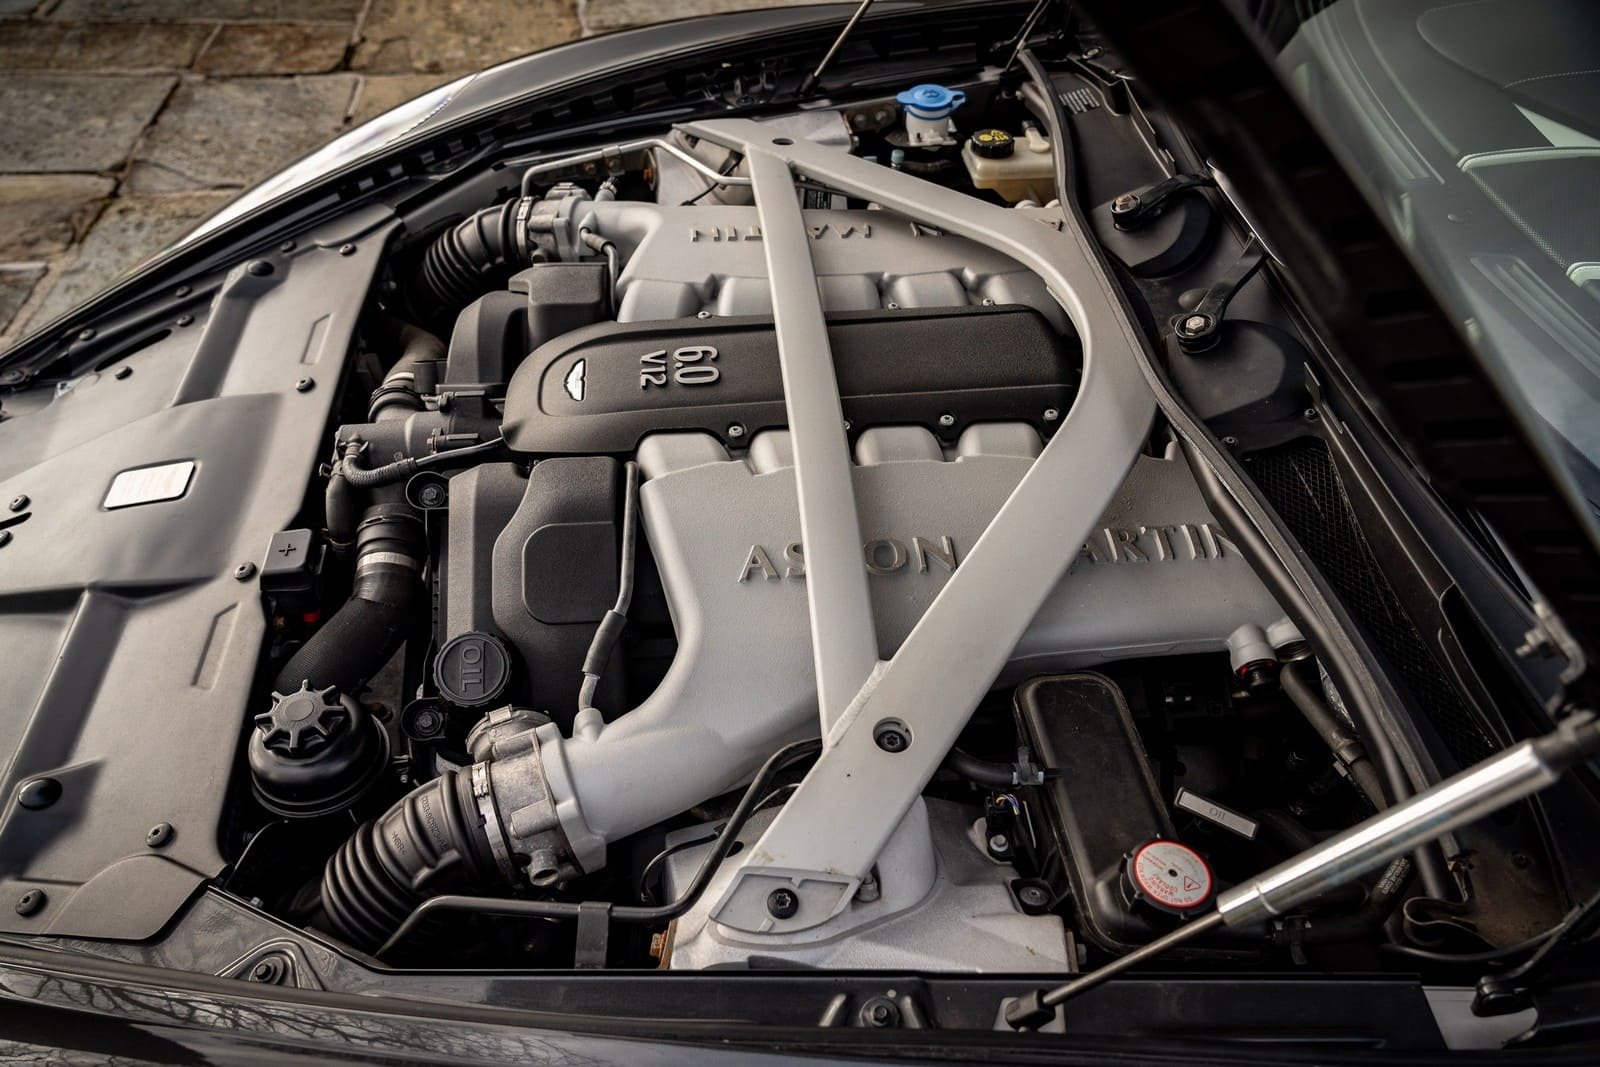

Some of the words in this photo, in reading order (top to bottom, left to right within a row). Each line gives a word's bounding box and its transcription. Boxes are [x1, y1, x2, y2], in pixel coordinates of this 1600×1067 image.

[640, 349, 667, 389] V12
[673, 345, 719, 385] 6.0
[737, 535, 958, 584] ASON
[462, 645, 482, 693] OIL
